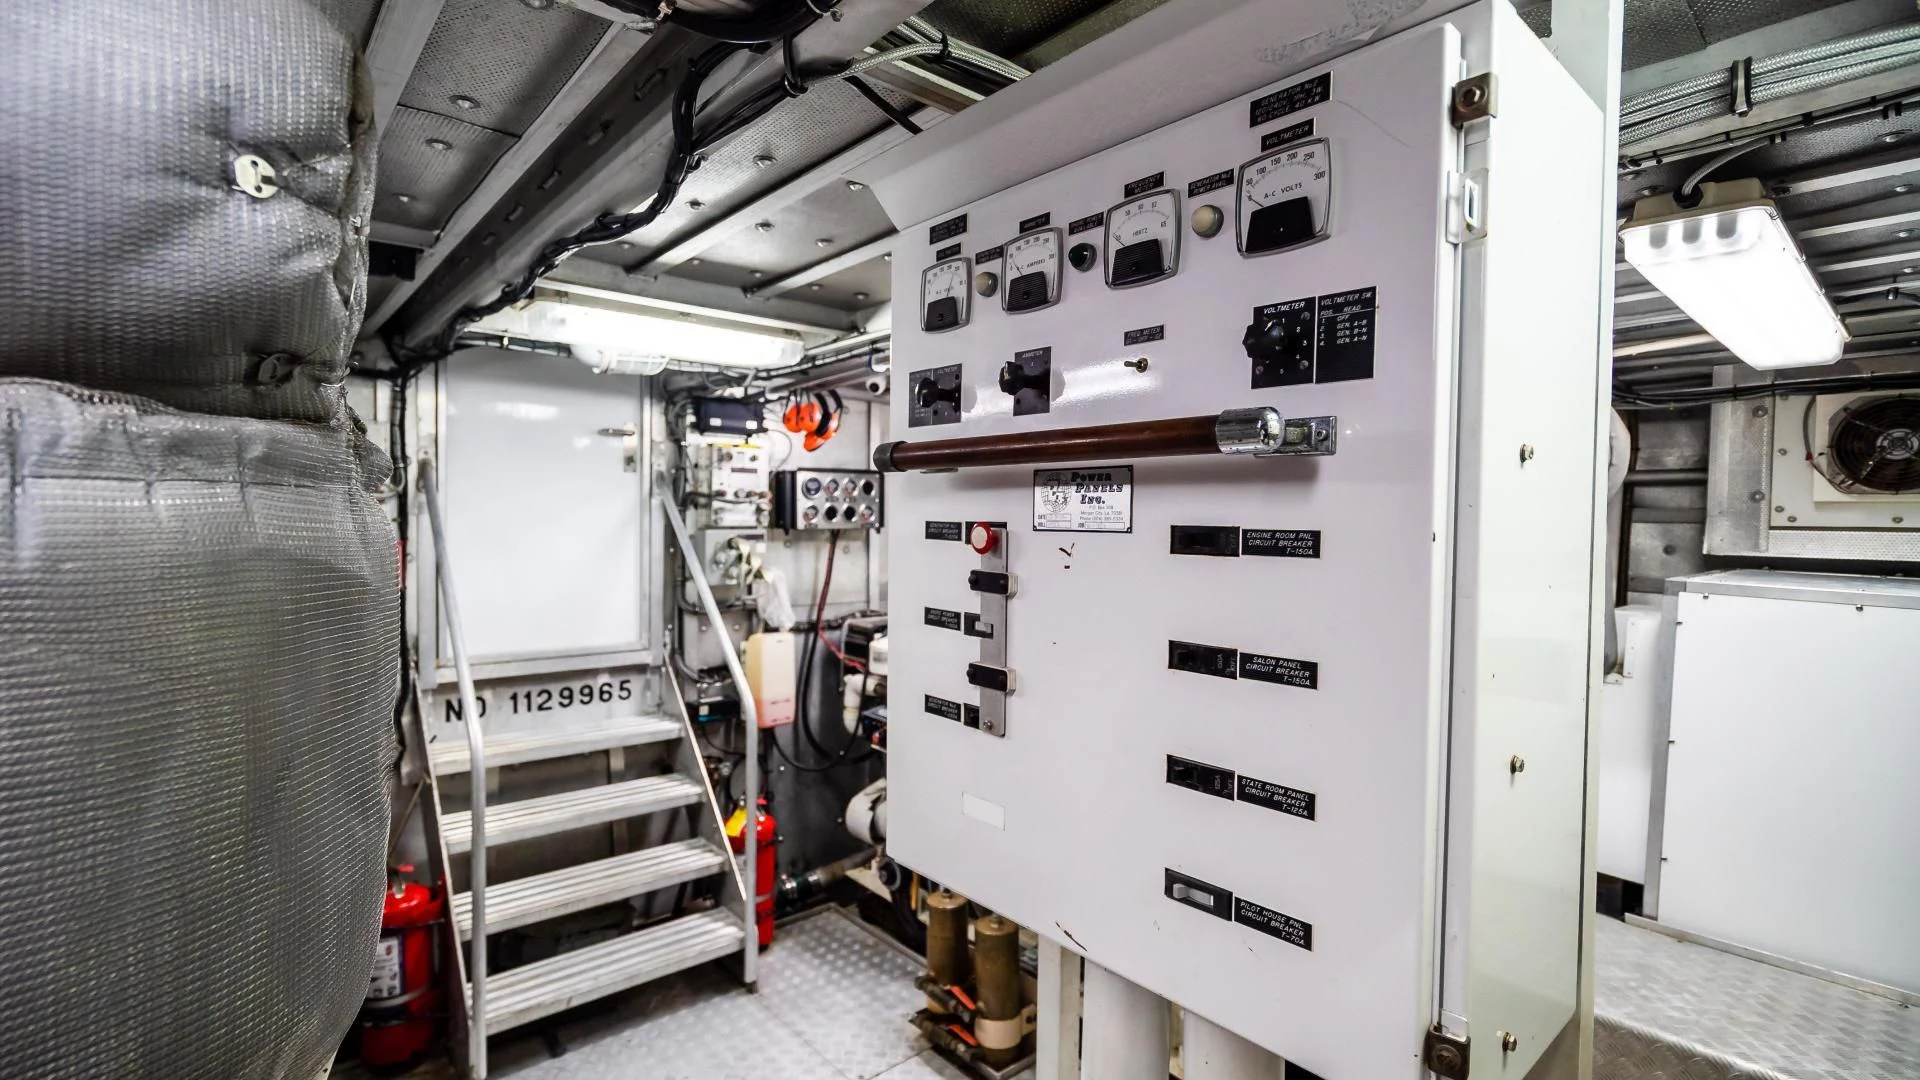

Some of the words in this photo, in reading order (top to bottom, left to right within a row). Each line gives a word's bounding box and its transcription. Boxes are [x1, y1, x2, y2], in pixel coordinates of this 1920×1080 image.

[1266, 126, 1309, 145] VOLTMETER
[1271, 157, 1281, 166] 150
[1287, 151, 1298, 161] 200
[1303, 151, 1315, 161] 250
[1256, 166, 1266, 176] 100
[1313, 171, 1326, 181] 300
[1246, 178, 1253, 186] 50
[1281, 182, 1302, 194] VOLTS
[1321, 294, 1360, 306] VOLTMETER
[1264, 302, 1305, 314] VOLTMETER
[1343, 304, 1361, 313] READ
[1248, 539, 1276, 547] CIRCUIT
[1278, 540, 1313, 548] BREAKER
[1286, 547, 1313, 555] T-150A
[1253, 656, 1276, 665] SALON
[1278, 659, 1302, 669] PANEL
[1245, 663, 1274, 673] CIRCUIT
[1275, 666, 1310, 678] BREAKER
[510, 679, 632, 714] 1129965
[1241, 778, 1262, 789] STATE
[1265, 783, 1285, 795] ROOM
[1287, 790, 1310, 801] PANEL
[1245, 787, 1271, 798] CIRCUIT
[1273, 794, 1306, 807] BREAKER
[1240, 901, 1260, 913] PILOT
[1263, 909, 1287, 923] HOUSE
[1241, 909, 1268, 923] CIRCUIT
[1270, 920, 1304, 937] BREAKER
[1281, 931, 1305, 945] T-70A
